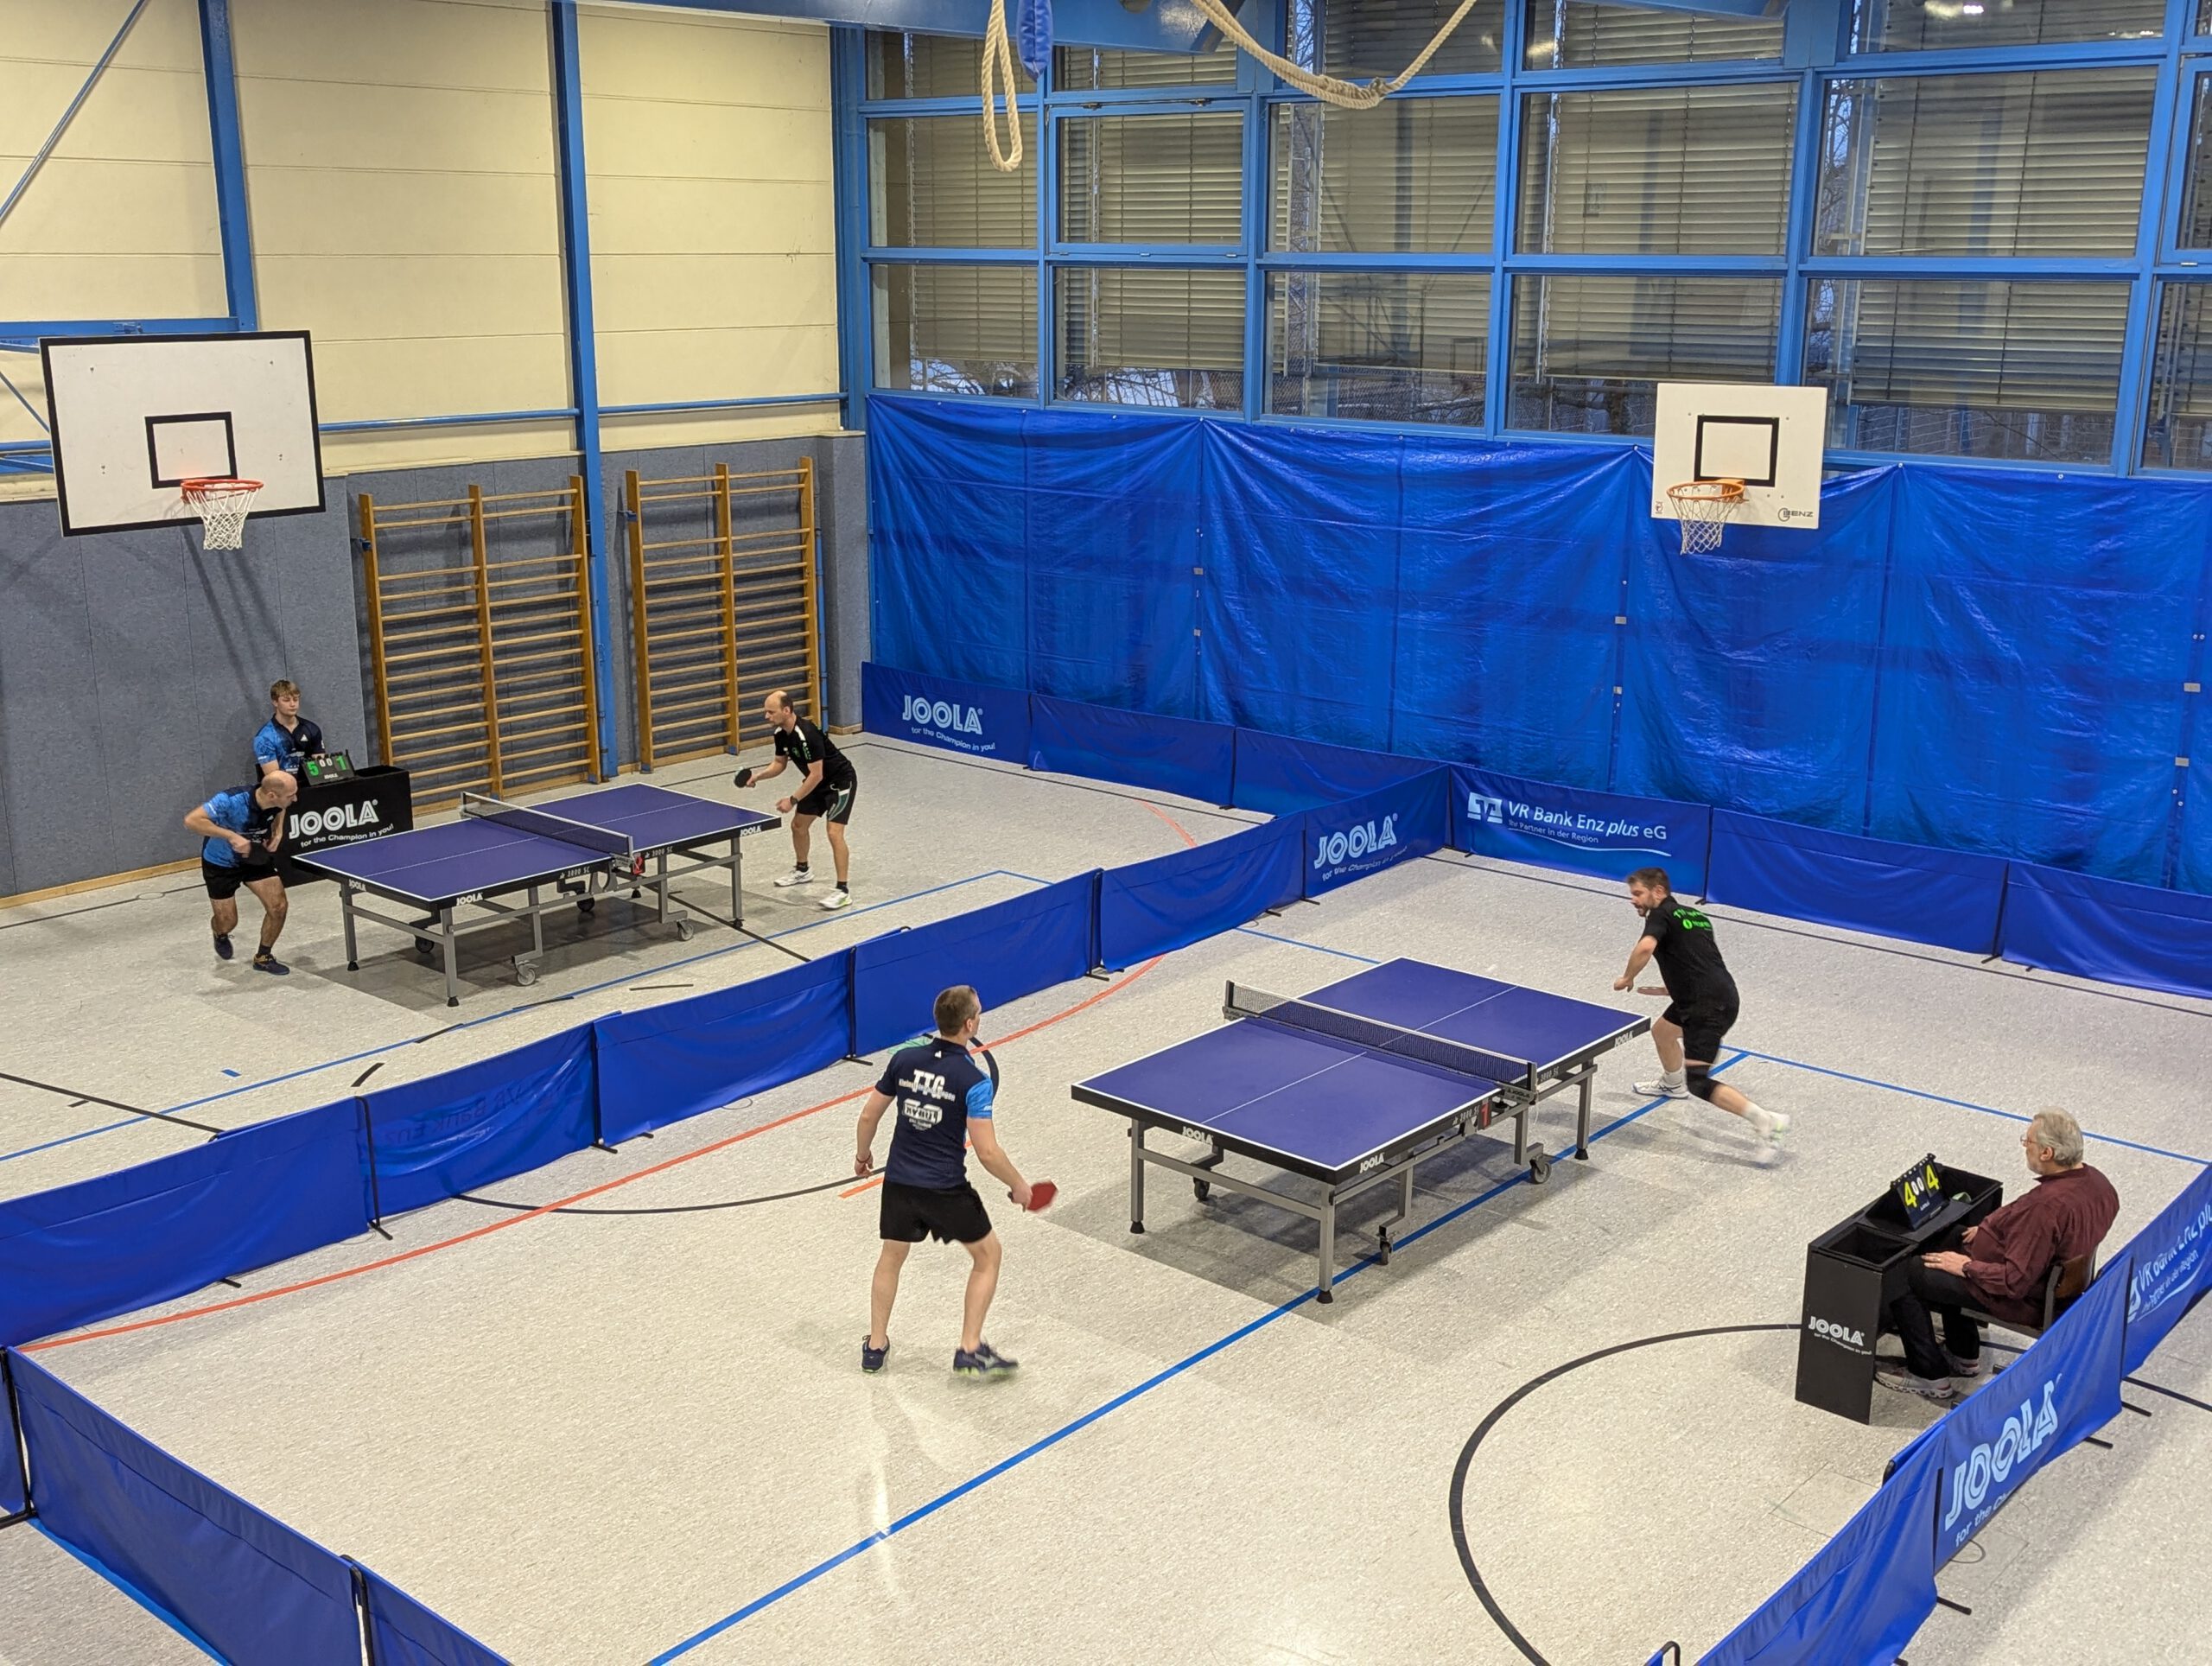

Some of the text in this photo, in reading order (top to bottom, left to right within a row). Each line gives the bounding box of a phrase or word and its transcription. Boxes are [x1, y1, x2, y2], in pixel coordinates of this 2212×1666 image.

[902, 695, 983, 735] JOOLA
[923, 728, 934, 736] the
[936, 731, 971, 749] Champion
[308, 761, 319, 776] 5
[336, 756, 346, 770] 1
[289, 800, 379, 839] JOOLA
[1509, 800, 1667, 840] VR Bank Enz plus eG
[328, 832, 367, 841] Champion
[378, 823, 394, 836] you!
[1313, 815, 1397, 869] JOOLA
[1519, 822, 1546, 834] Partner
[1548, 827, 1555, 836] in
[1557, 830, 1569, 838] der
[1572, 832, 1599, 843] Region
[1322, 870, 1332, 881] for
[456, 892, 484, 906] JOOLA
[912, 1068, 945, 1099] TTG
[1182, 1126, 1213, 1145] JOOLA
[1359, 1152, 1384, 1173] JOOLA
[1910, 1180, 1919, 1195] 0
[1916, 1177, 1924, 1192] 0
[1926, 1164, 1939, 1190] 4
[1904, 1181, 1917, 1208] 4
[1808, 1315, 1864, 1346] JOOLA
[1945, 1380, 2058, 1531] JOOLA
[1955, 1505, 1993, 1548] for the
